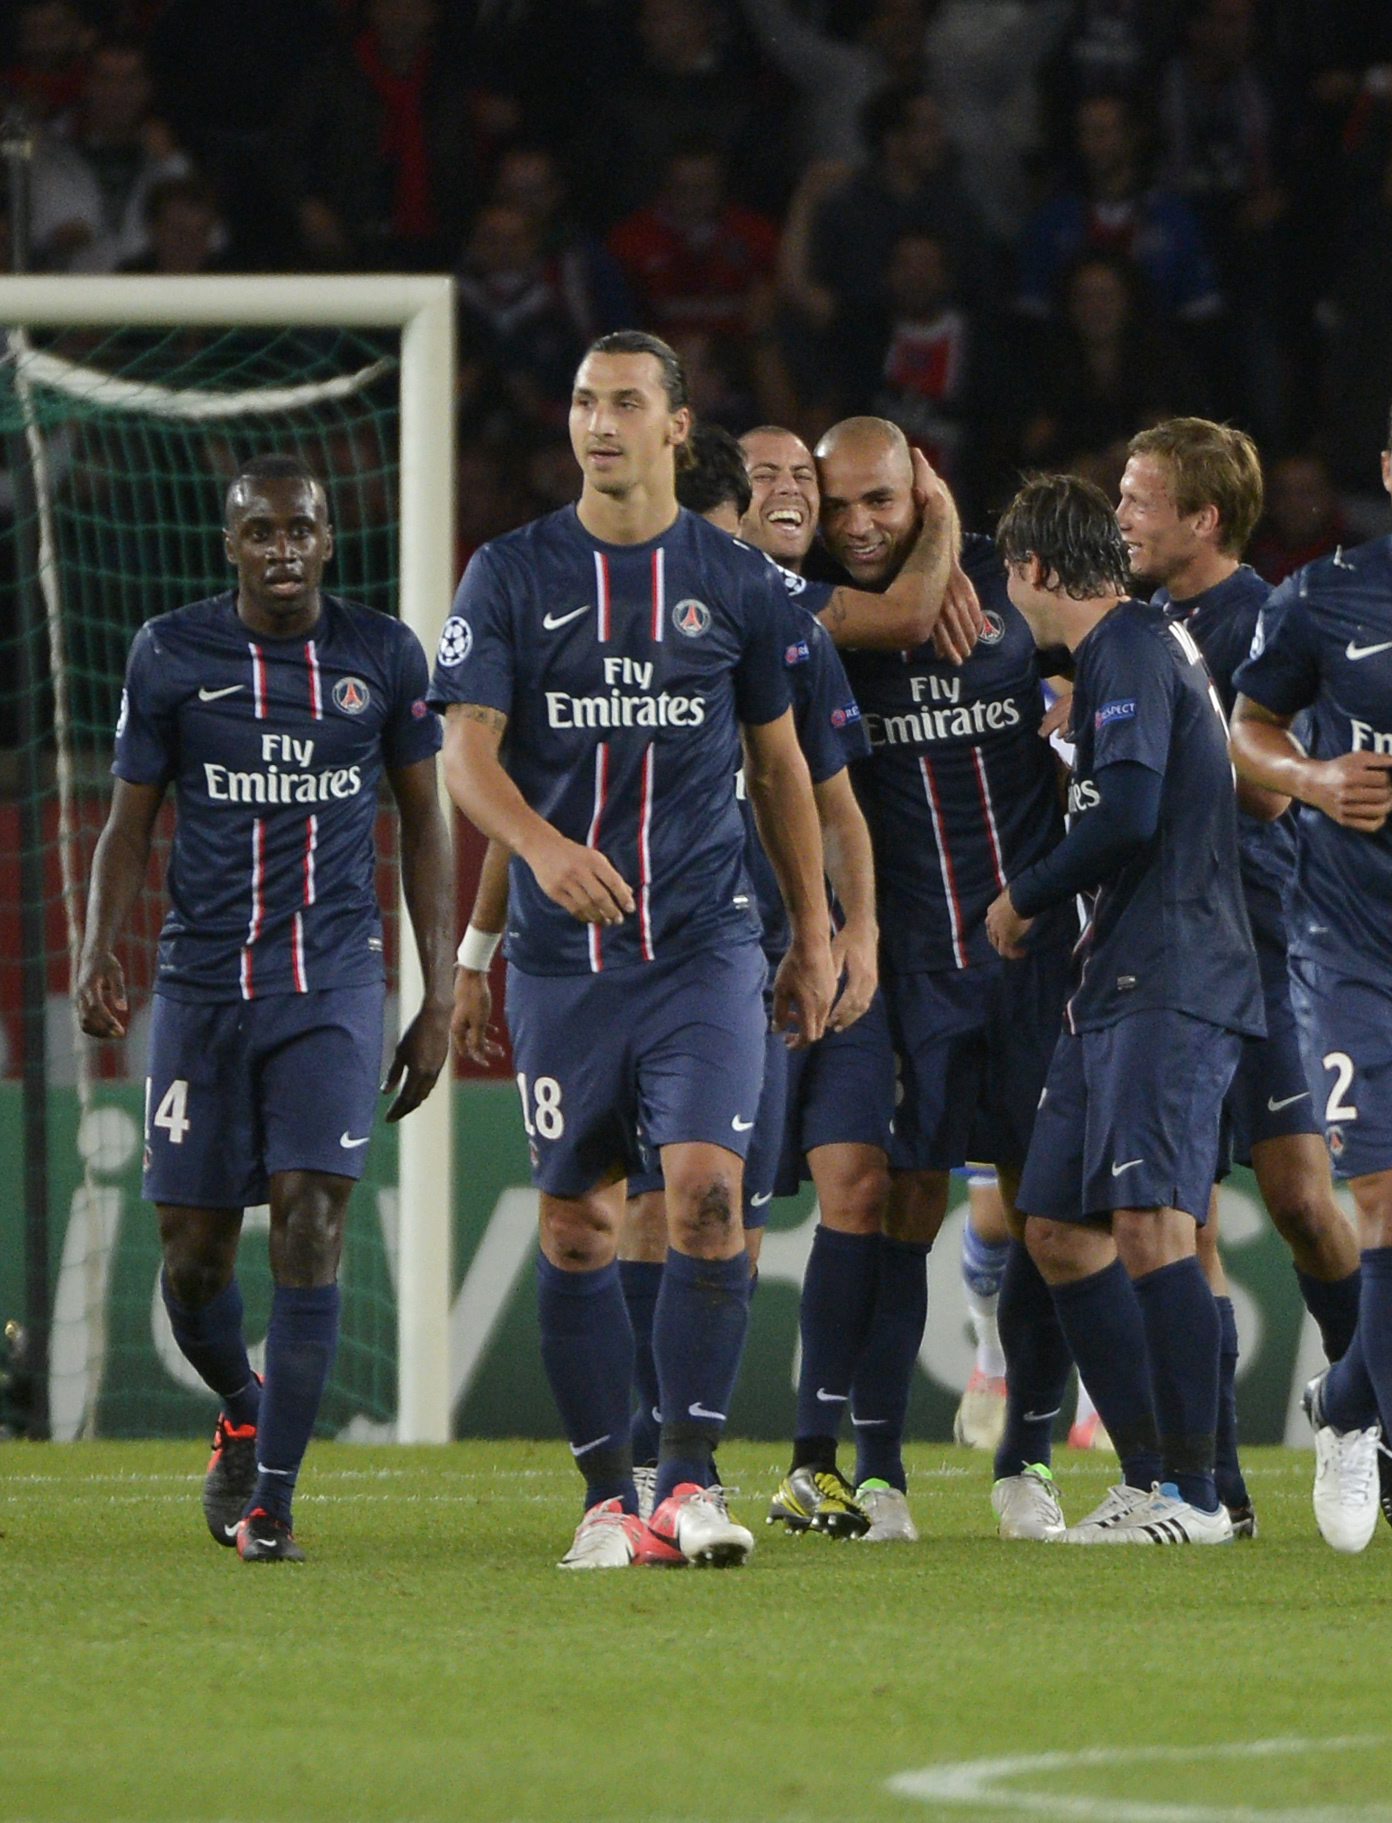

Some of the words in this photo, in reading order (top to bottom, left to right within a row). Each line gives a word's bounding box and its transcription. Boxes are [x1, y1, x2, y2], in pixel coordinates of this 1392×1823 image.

[603, 657, 653, 690] Fly
[911, 675, 962, 704] Fly
[545, 687, 705, 728] Emirates
[862, 697, 1020, 747] Emirates
[262, 734, 314, 768] Fly
[203, 763, 362, 803] Emirates
[516, 1072, 564, 1140] 18
[1323, 1051, 1358, 1121] 2
